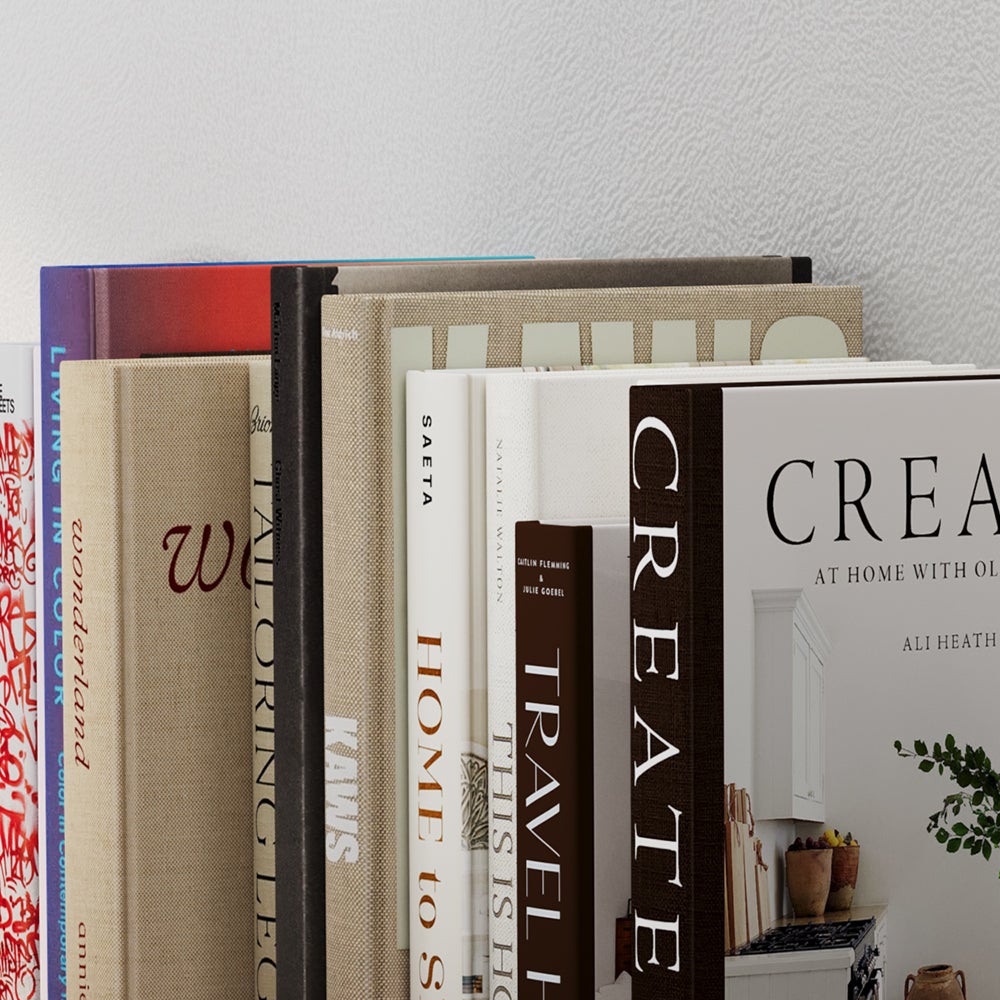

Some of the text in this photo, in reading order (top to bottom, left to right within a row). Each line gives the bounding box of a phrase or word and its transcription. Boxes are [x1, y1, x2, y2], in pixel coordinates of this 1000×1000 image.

[422, 415, 433, 506] SAETA
[50, 346, 65, 706] LIVING IN COLOR
[517, 557, 570, 570] CAITLIN FLEMMING
[539, 574, 544, 582] &
[815, 567, 839, 585] AT
[847, 564, 905, 584] HOME
[912, 561, 967, 580] WITH
[73, 517, 90, 769] wonderland
[522, 585, 565, 597] JULIE GOEBEL
[902, 632, 997, 652] ALI HEATH
[254, 464, 276, 846] TAILORING
[634, 416, 683, 972] CREATE
[325, 716, 360, 864] KAWS
[416, 634, 444, 844] HOME
[491, 721, 514, 855] THIS
[524, 647, 561, 940] TRAVEL
[418, 869, 439, 930] to
[491, 873, 514, 920] IS
